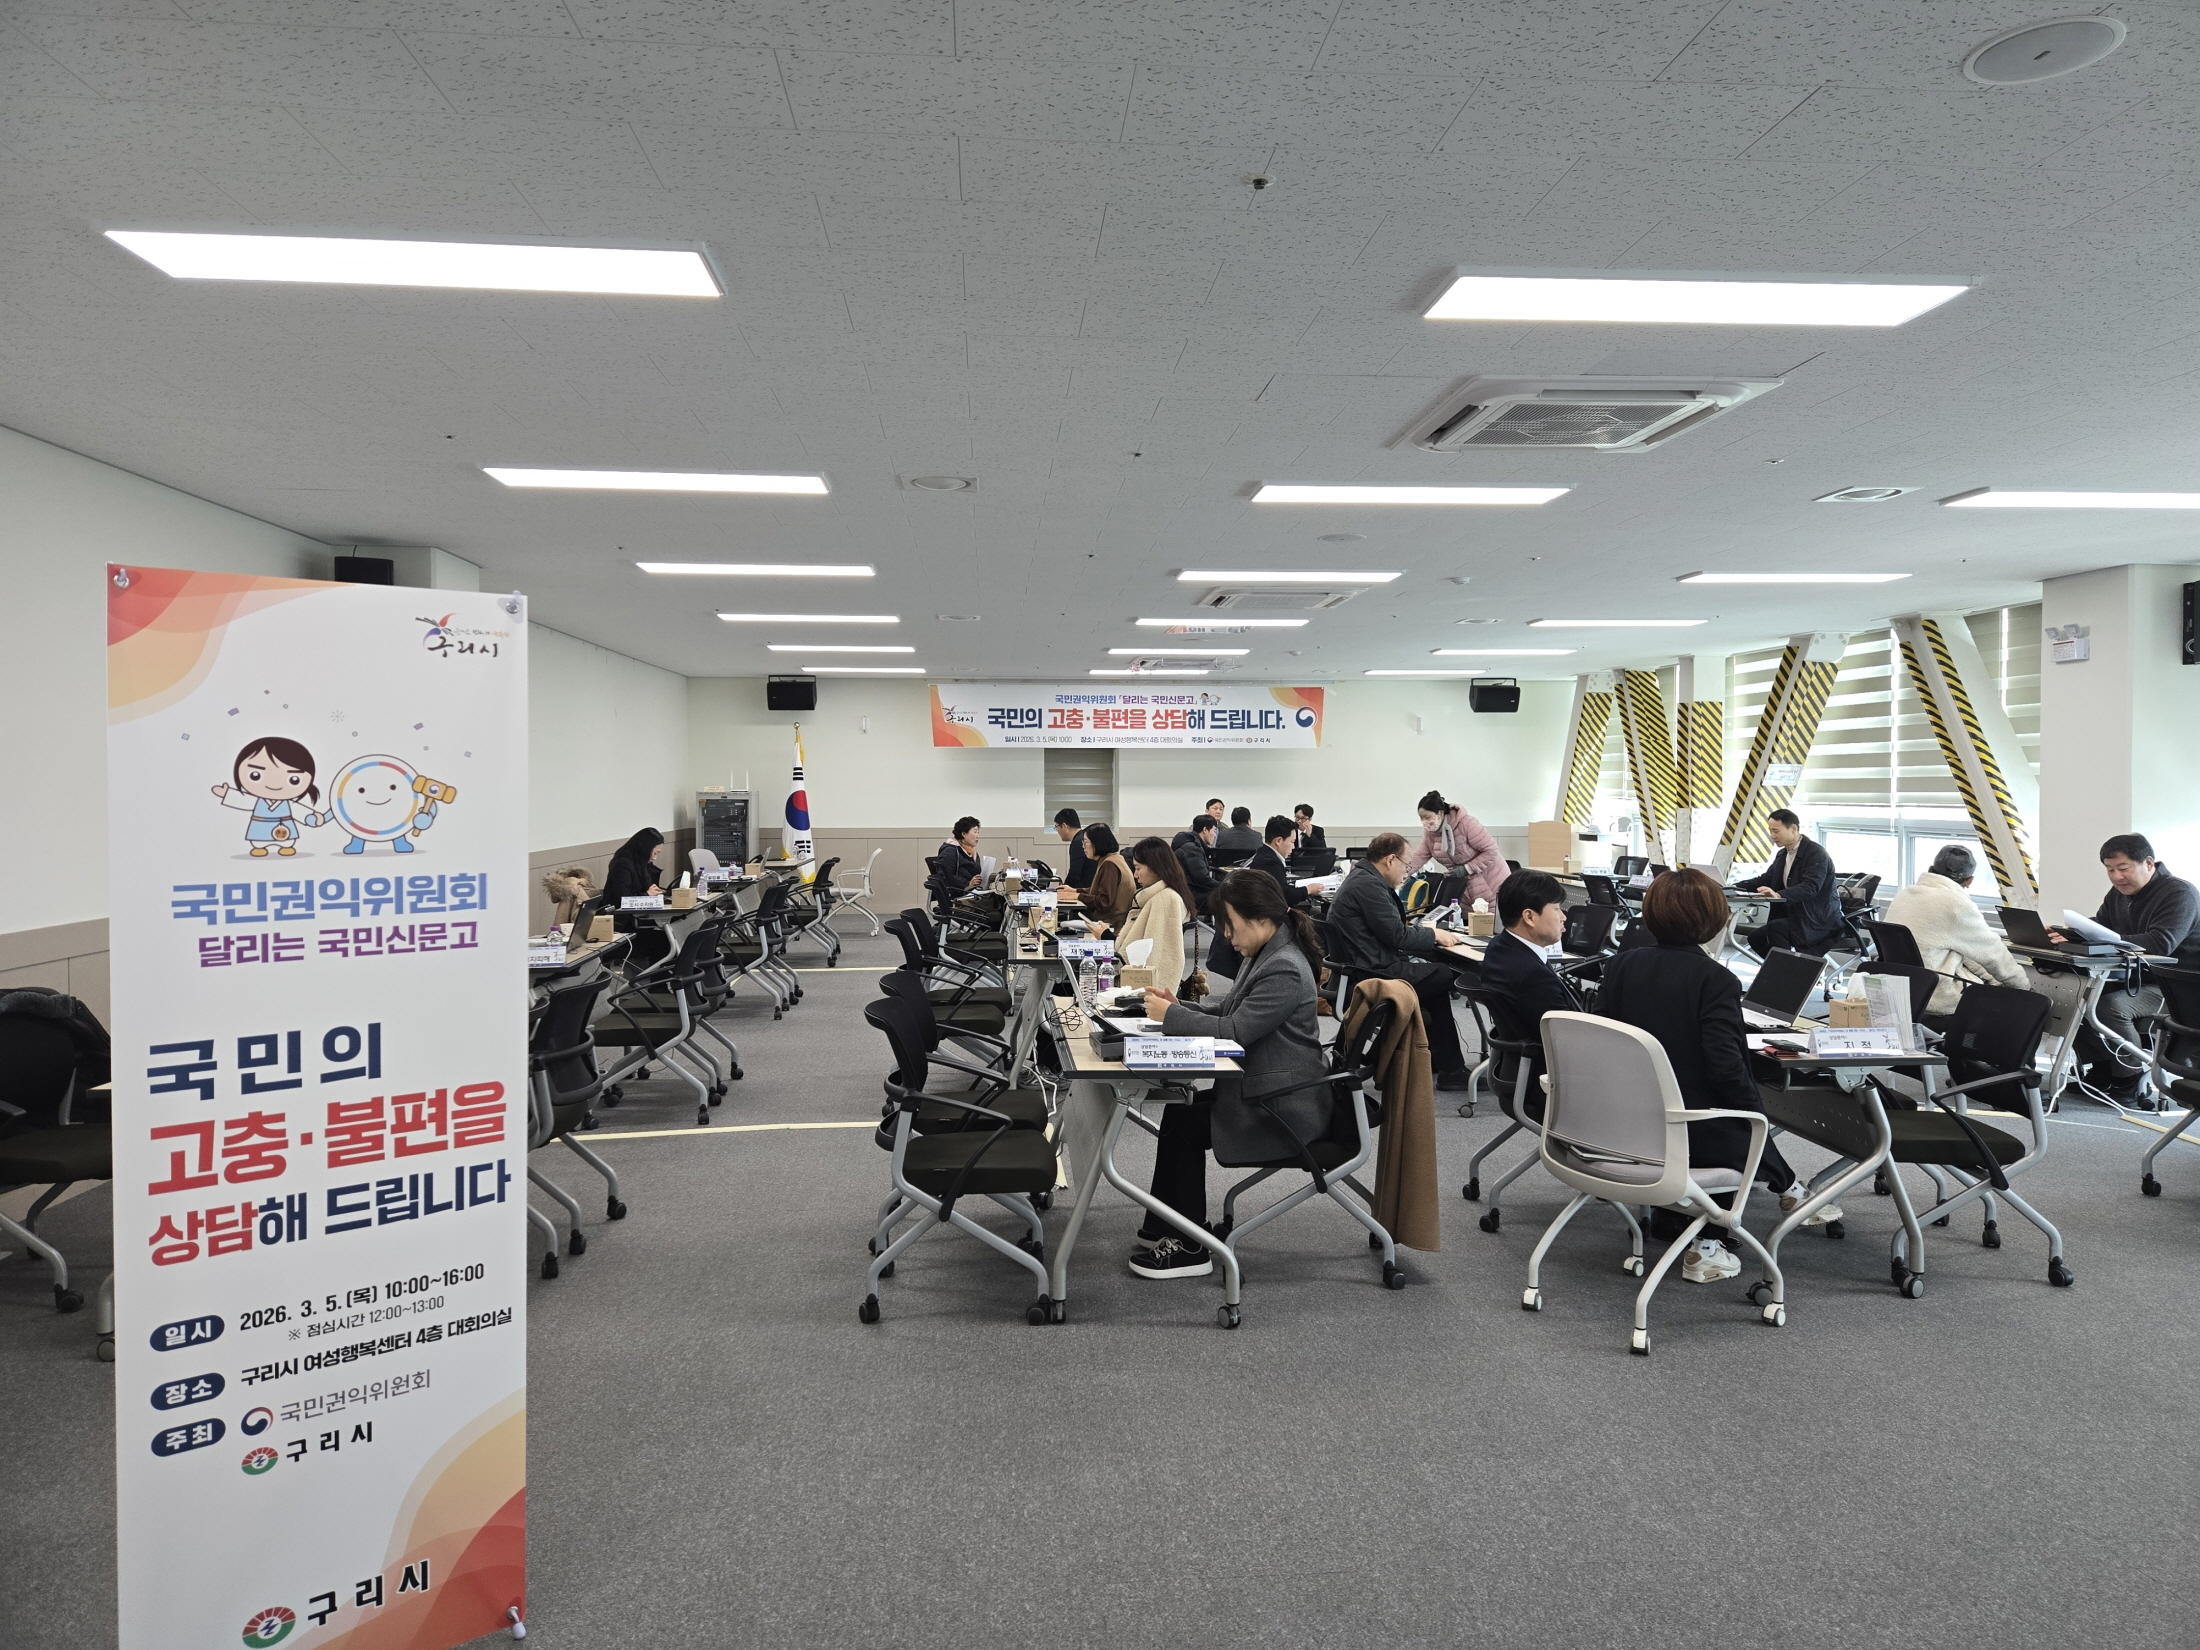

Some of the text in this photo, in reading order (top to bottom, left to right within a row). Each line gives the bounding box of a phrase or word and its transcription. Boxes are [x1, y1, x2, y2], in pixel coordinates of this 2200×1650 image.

[427, 635, 498, 658] 구리시
[988, 708, 1286, 730] 국민의 고충·불편을 상담해 드립니다.
[1054, 694, 1117, 705] 국민권익위원회
[171, 873, 488, 925] 국민권익위원회
[199, 921, 479, 968] 달리는 국민신문고
[147, 1022, 382, 1101] 국민의
[148, 1081, 507, 1196] 고충·불편을
[148, 1158, 511, 1267] 상담해 드립니다
[165, 1319, 212, 1347] 일시
[240, 1305, 292, 1331] 2026.
[300, 1300, 317, 1318] 3.
[384, 1263, 485, 1300] 10:00~16:00
[306, 1315, 366, 1338] 점심시간
[368, 1295, 445, 1324] 12:00~13:00
[165, 1306, 513, 1405] 장소 구리시 여성행복센터 4층 대회의실
[165, 1368, 432, 1451] 주최 국민권익위원회
[286, 1420, 374, 1463] 구리시
[306, 1558, 431, 1627] 구리시
